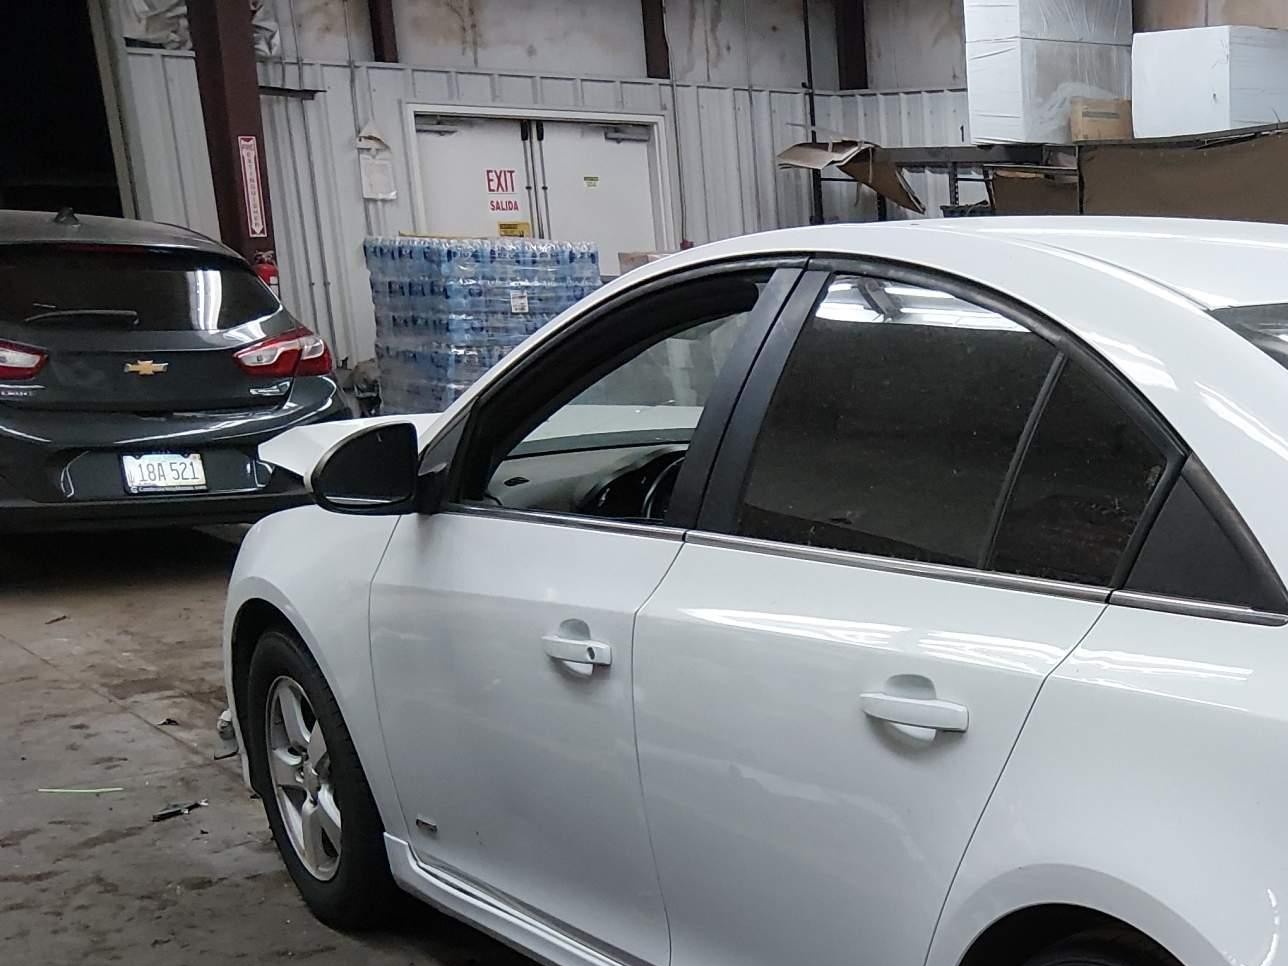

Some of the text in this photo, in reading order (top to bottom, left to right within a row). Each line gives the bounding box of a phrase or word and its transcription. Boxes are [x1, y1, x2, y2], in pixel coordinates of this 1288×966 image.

[486, 169, 516, 193] EXIT
[489, 199, 519, 211] SALIDA
[138, 461, 201, 482] 18A 521
